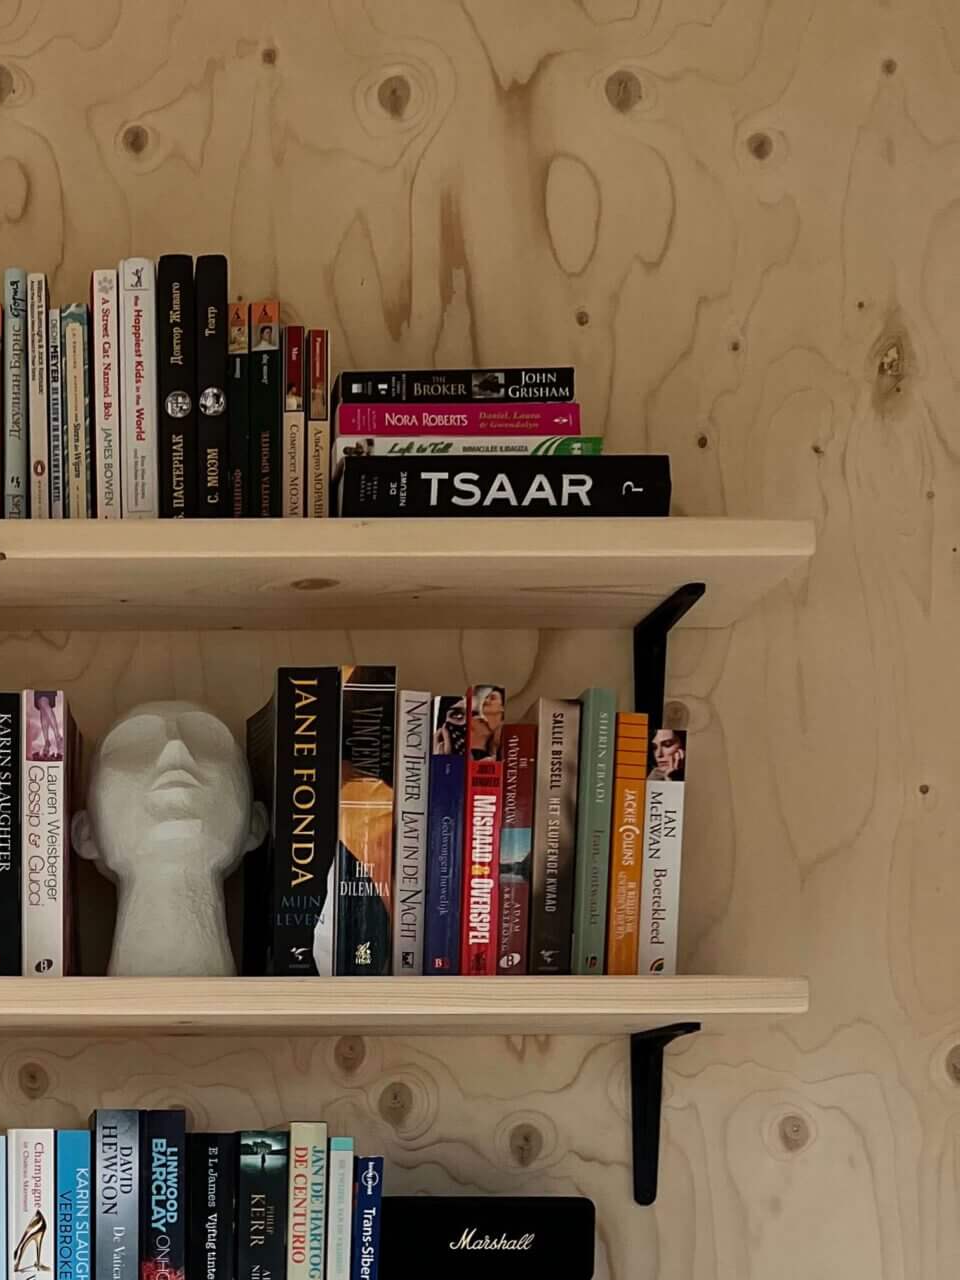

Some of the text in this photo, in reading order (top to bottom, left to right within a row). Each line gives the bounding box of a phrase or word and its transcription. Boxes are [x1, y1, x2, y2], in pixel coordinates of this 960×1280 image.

[102, 297, 110, 305] A
[102, 309, 110, 338] Street
[133, 309, 143, 357] Happiest
[51, 345, 59, 383] MEYER
[103, 341, 111, 359] Cat
[103, 363, 111, 397] Named
[136, 361, 144, 383] Kids
[413, 382, 466, 395] BROKER
[521, 372, 556, 384] JOHN
[508, 385, 569, 398] GRISHAM
[135, 408, 145, 440] World
[385, 413, 417, 426] NORA
[422, 414, 467, 426] ROBERTS
[103, 427, 113, 506] JAMES BOWEN
[390, 481, 397, 495] DE
[399, 471, 407, 507] NIEUWE
[420, 472, 593, 506] TSAAR
[289, 678, 318, 887] JANE FONDA
[26, 765, 44, 906] Gossip & Gucci
[44, 765, 59, 901] Lauren Weisberger
[649, 792, 661, 859] McEWAN
[664, 810, 677, 837] IAN
[469, 795, 496, 944] MISDAAD & OVERSPEL
[650, 868, 667, 944] Boetekleed
[152, 1138, 165, 1232] BARCLAY
[167, 1147, 178, 1223] LINWOOD
[450, 1228, 534, 1250] Marshall
